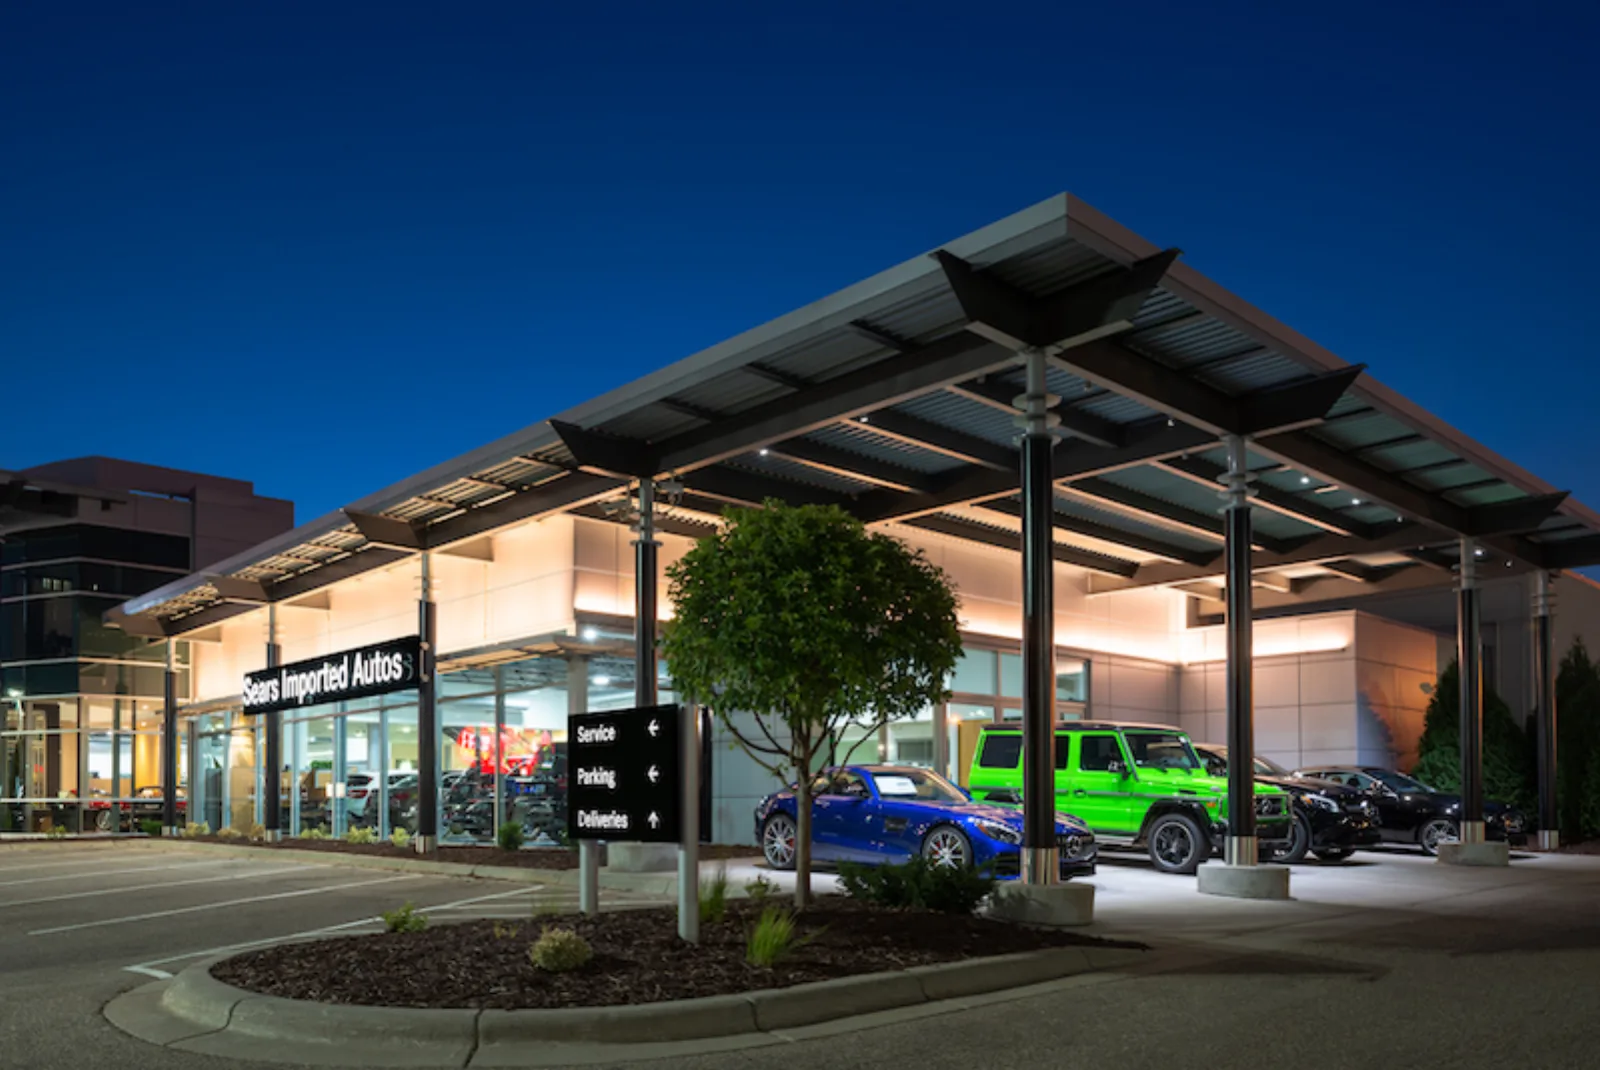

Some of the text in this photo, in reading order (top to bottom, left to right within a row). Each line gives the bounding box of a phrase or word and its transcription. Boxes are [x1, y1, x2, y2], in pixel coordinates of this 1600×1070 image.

[243, 650, 402, 706] Sears Imported Autos
[577, 724, 616, 743] Service
[577, 766, 616, 789] Parking
[577, 810, 629, 829] Deliveries
